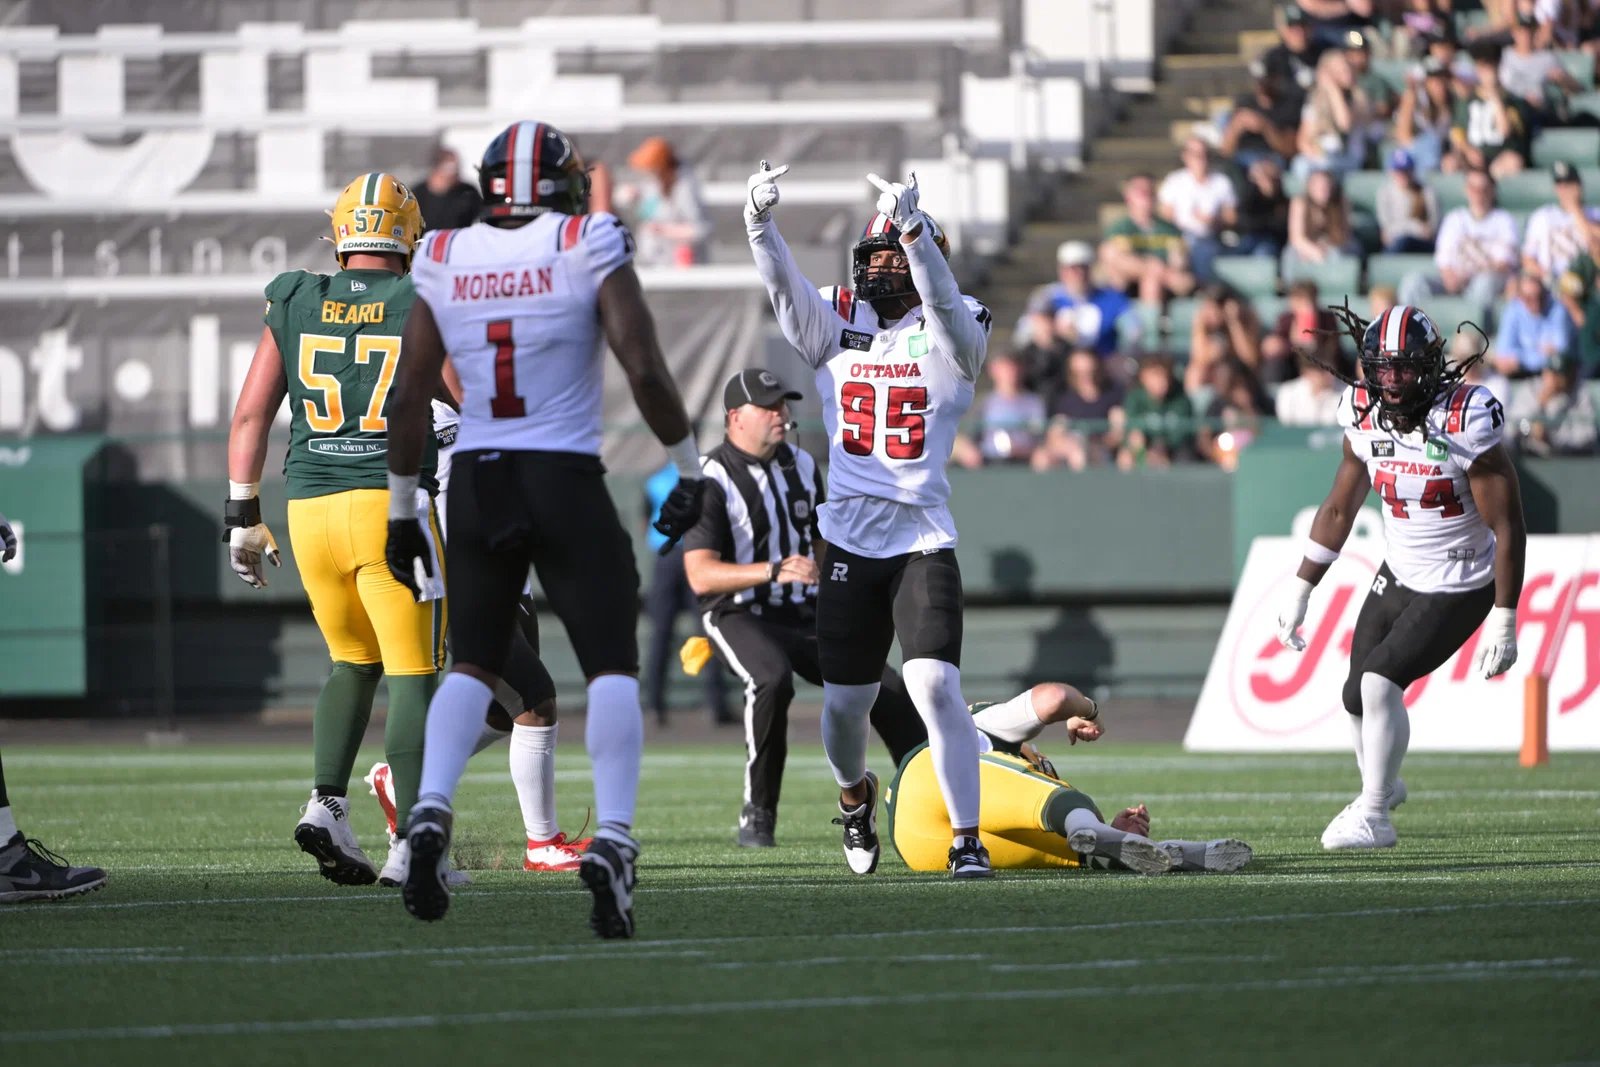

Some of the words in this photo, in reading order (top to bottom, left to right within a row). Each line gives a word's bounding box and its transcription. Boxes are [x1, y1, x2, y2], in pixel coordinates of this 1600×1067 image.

[355, 208, 385, 234] 57
[342, 241, 399, 250] EDMONTON
[452, 267, 553, 301] MORGAN
[321, 300, 386, 325] BEARD
[844, 331, 871, 343] TOONIE
[848, 340, 862, 349] BET
[487, 318, 527, 418] 1
[850, 362, 922, 379] OTTAWA
[299, 333, 402, 433] 57
[841, 381, 928, 460] 95
[318, 443, 339, 451] ARPI'S
[340, 443, 364, 452] NORTH
[366, 443, 381, 451] INC.
[442, 434, 455, 445] BET
[1379, 460, 1443, 477] OTTAWA
[1373, 469, 1465, 520] 44
[318, 796, 345, 821] NIKE
